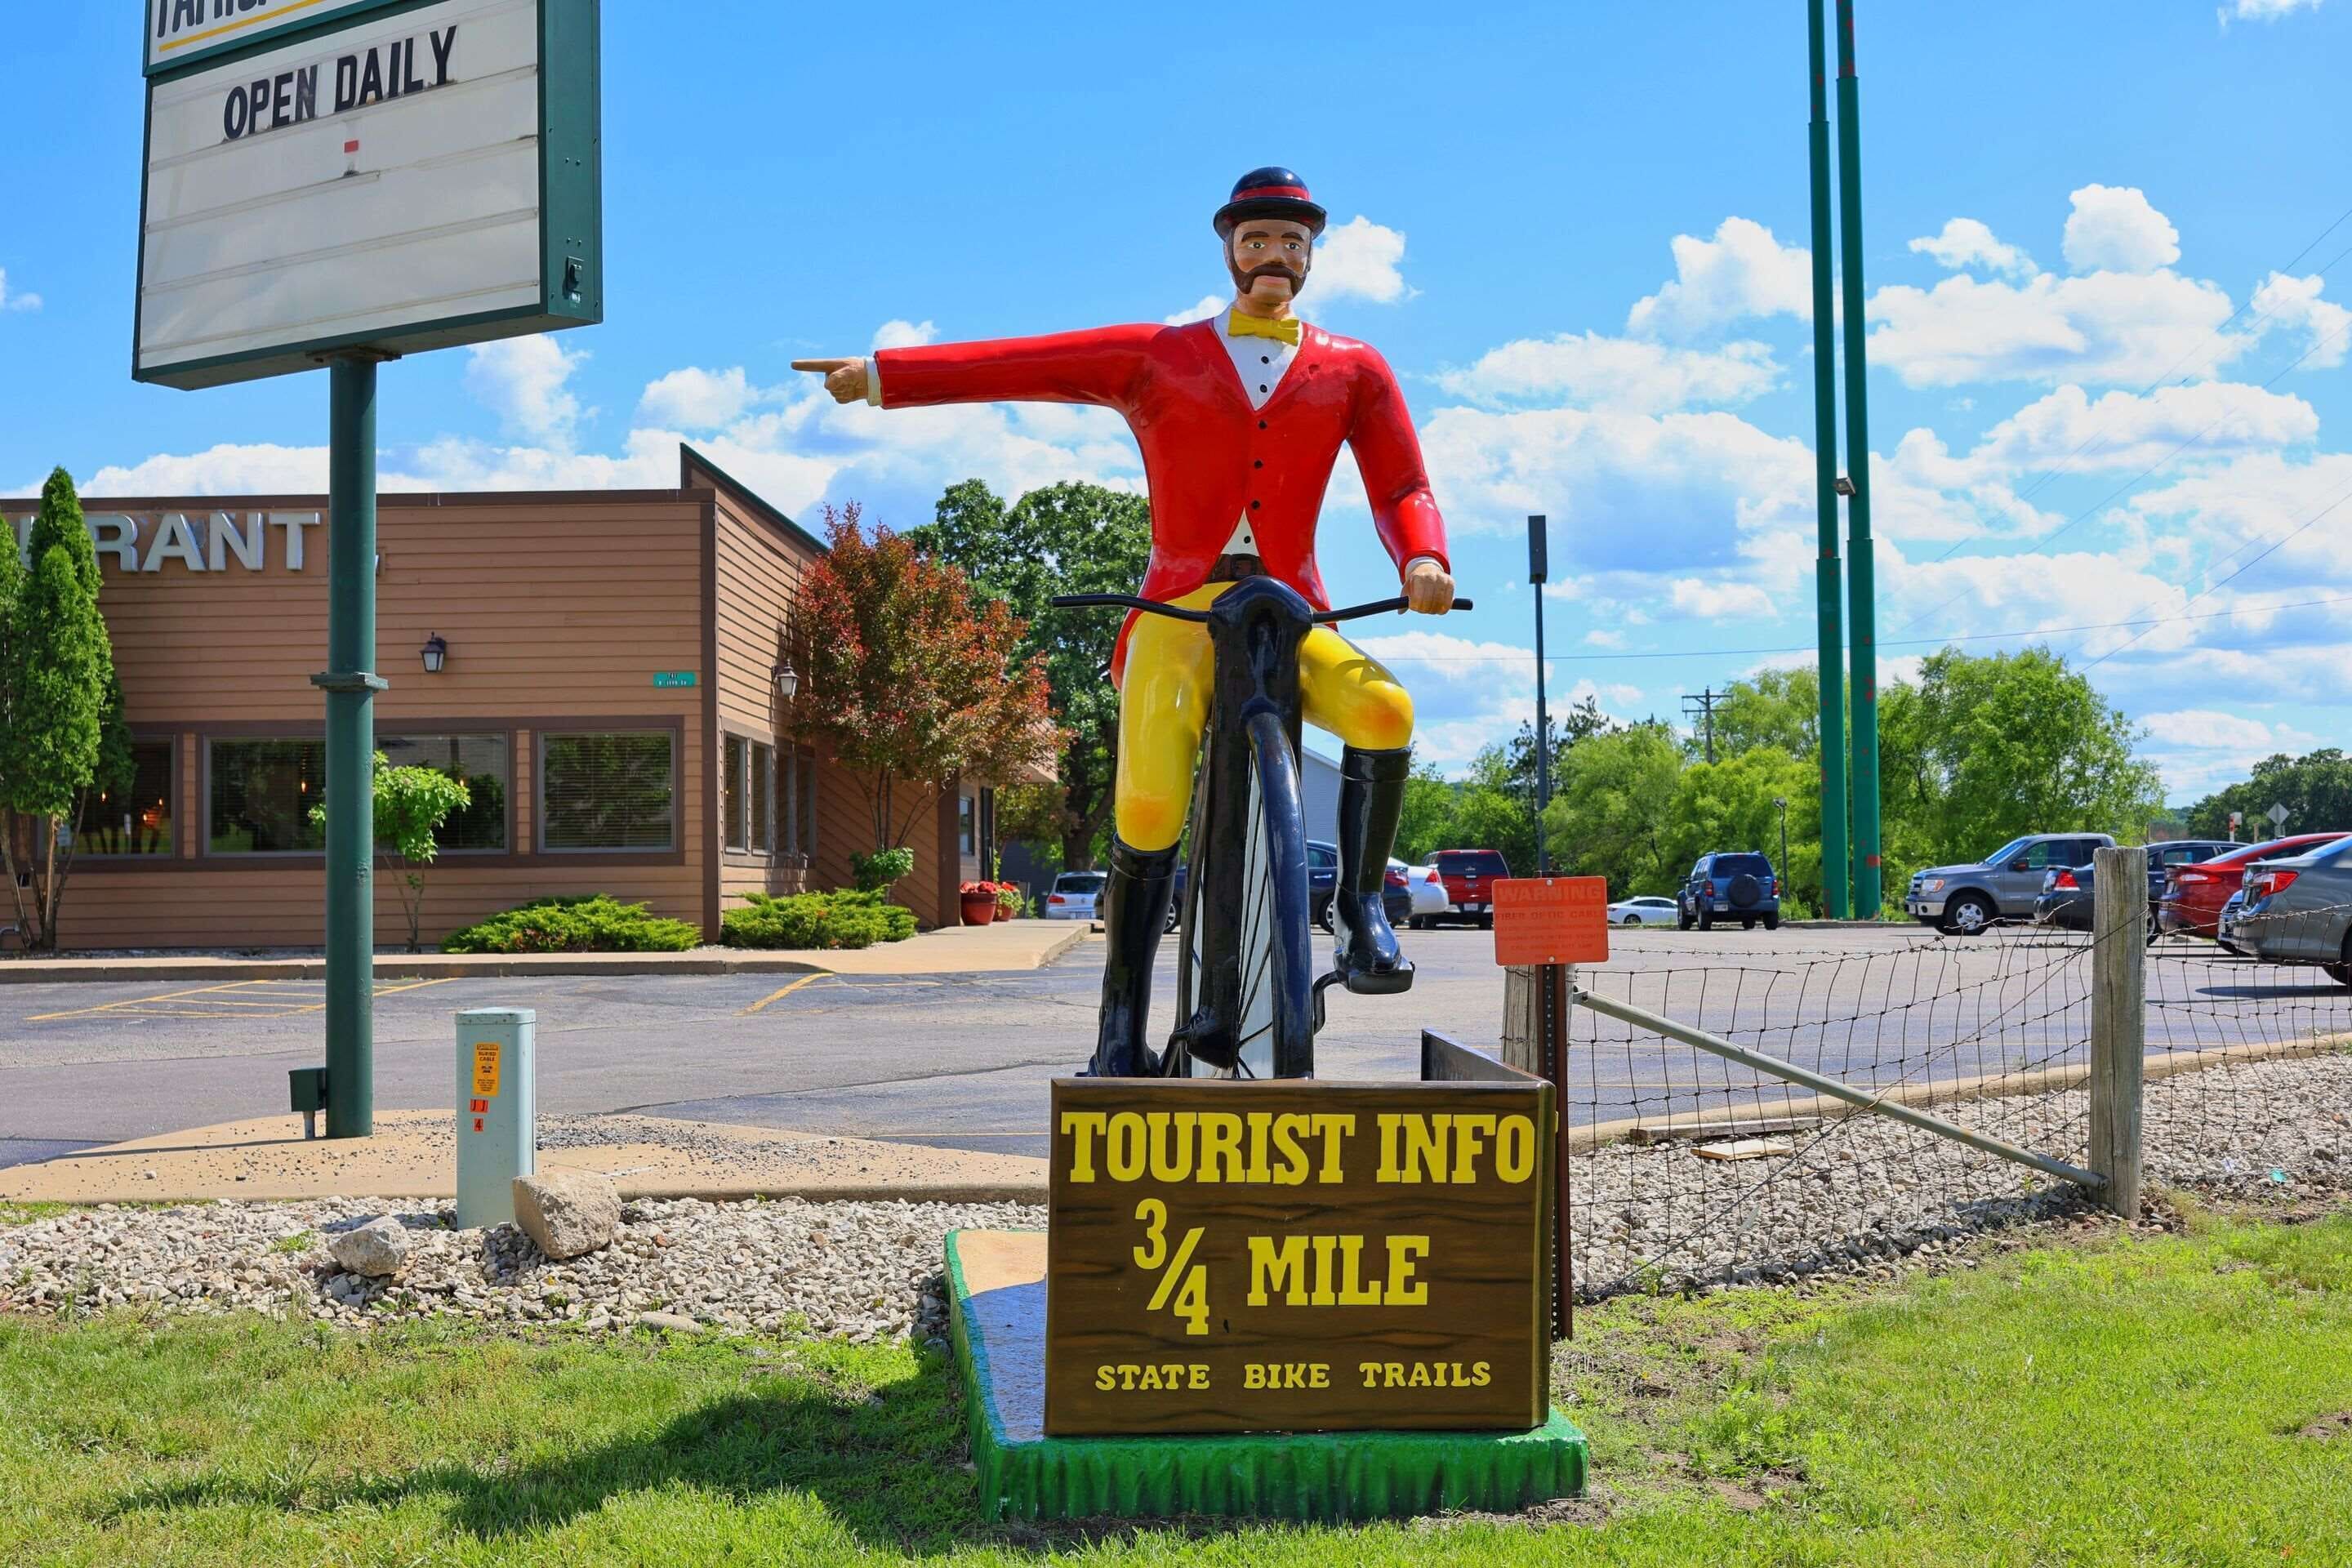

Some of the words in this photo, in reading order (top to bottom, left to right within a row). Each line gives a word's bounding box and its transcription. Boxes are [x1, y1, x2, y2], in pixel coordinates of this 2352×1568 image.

[224, 65, 318, 140] OPEN
[335, 24, 457, 113] DAILY
[1497, 885, 1601, 902] WARNING
[1062, 1111, 1356, 1186] TOURIST
[1376, 1112, 1535, 1184] INFO
[1247, 1235, 1430, 1307] MILE
[1095, 1364, 1210, 1391] STATE
[1243, 1363, 1330, 1390] BIKE
[1359, 1361, 1491, 1388] TRAILS
